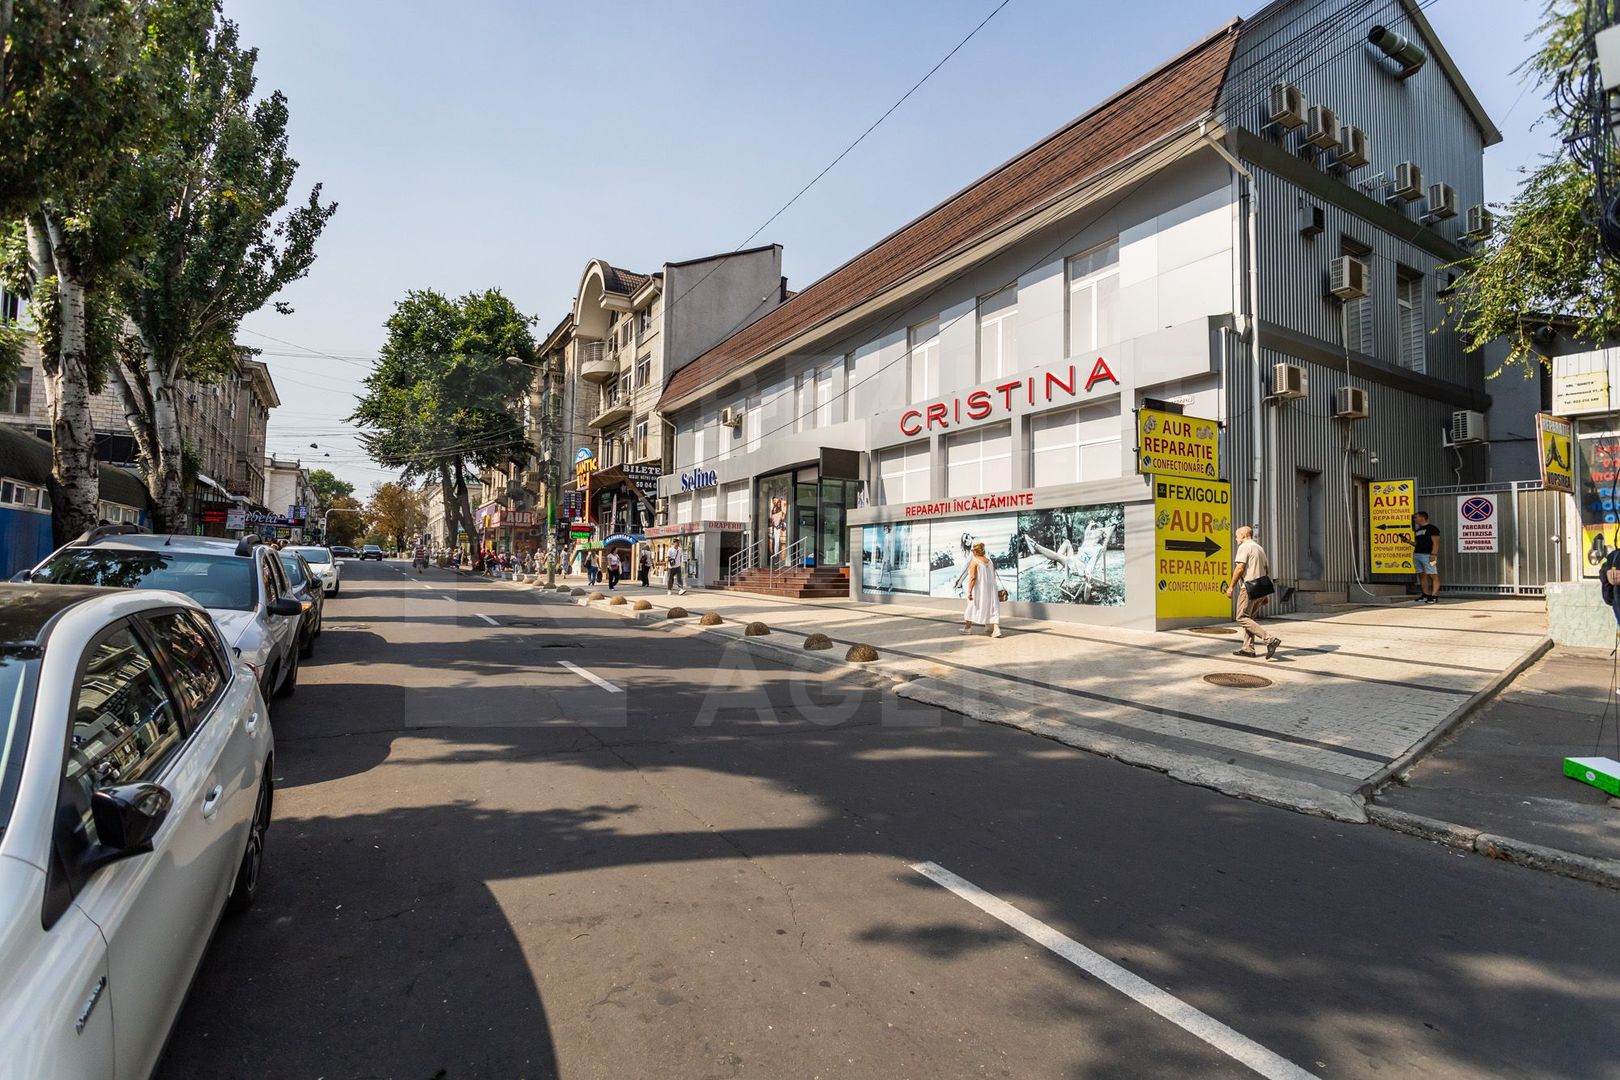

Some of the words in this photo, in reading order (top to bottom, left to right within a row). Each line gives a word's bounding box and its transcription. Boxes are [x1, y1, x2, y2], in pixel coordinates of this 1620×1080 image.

[899, 356, 1120, 437] CRISTINA
[1162, 420, 1191, 438] AUR
[1144, 436, 1213, 464] REPARAȚIE
[622, 464, 662, 475] BILETE
[1152, 457, 1204, 474] CONFECȚIONARE
[681, 467, 719, 492] Seline
[905, 502, 951, 516] REPARAȚII
[953, 493, 1033, 512] ÎNCĂLȚĂMINTE
[1168, 484, 1229, 505] FEXIGOLD
[1373, 495, 1410, 508] AUR
[506, 512, 531, 523] AUR
[1169, 509, 1214, 534] AUR
[1159, 558, 1228, 580] REPARAȚIE
[1168, 581, 1219, 594] CONFECȚIONARE
